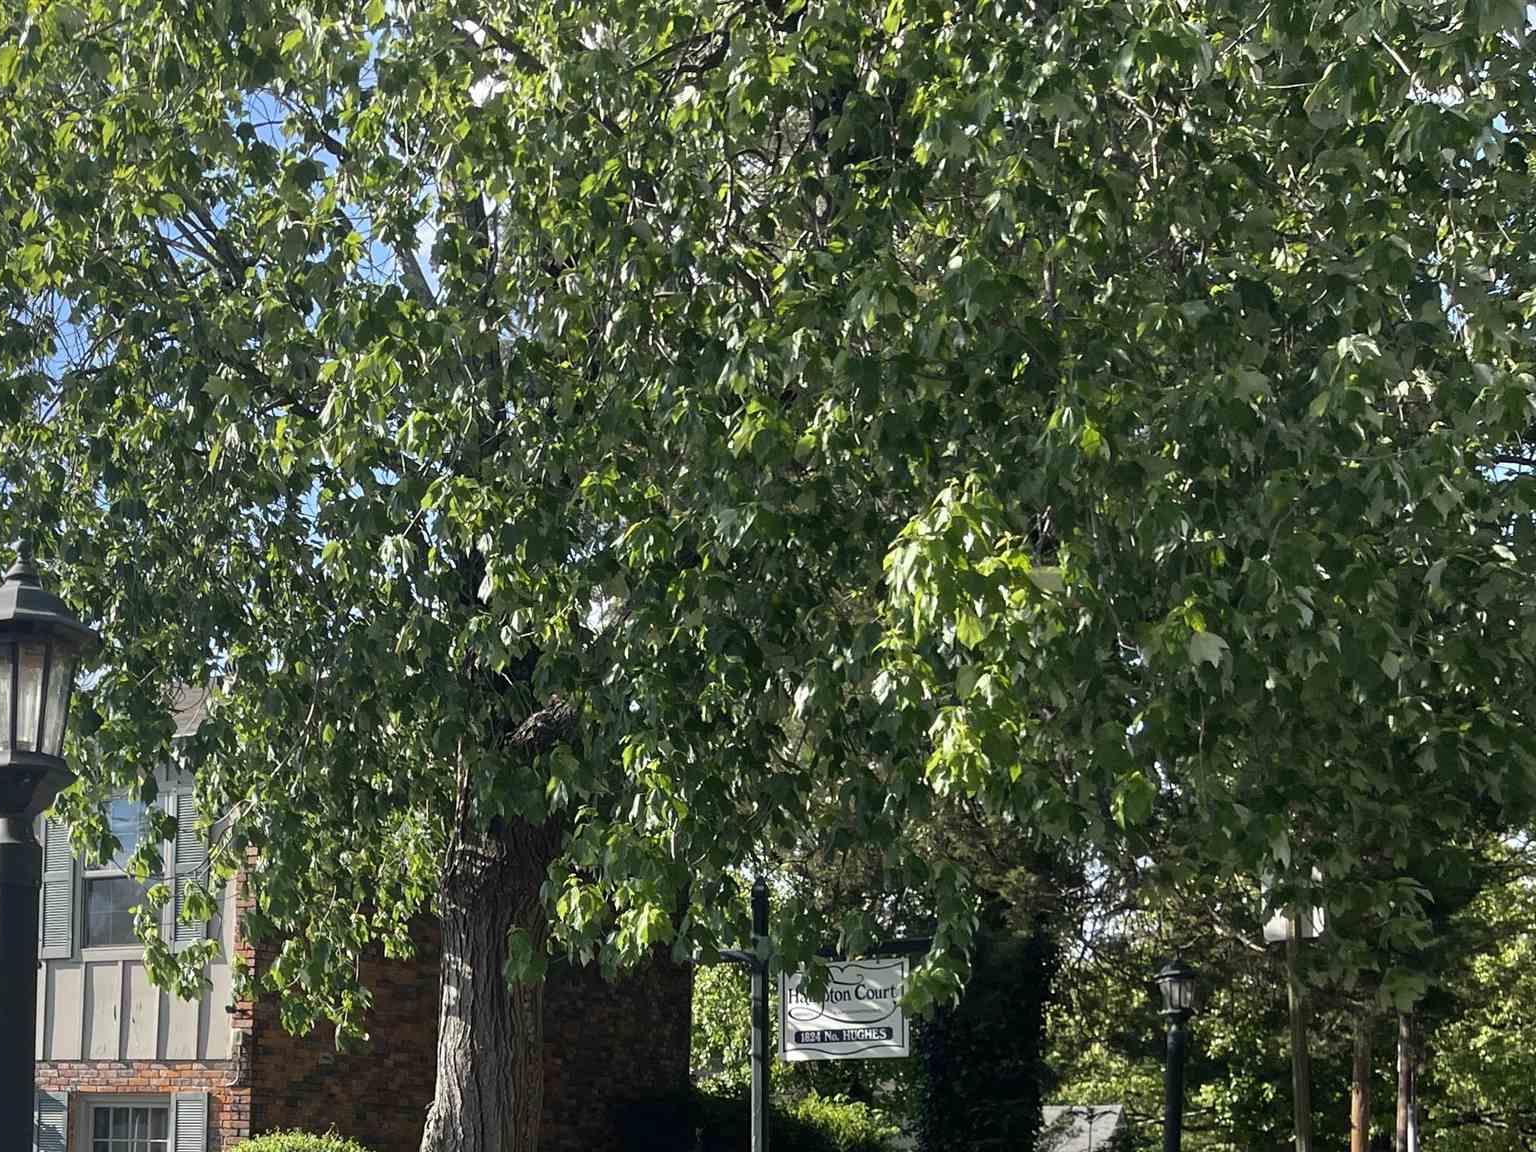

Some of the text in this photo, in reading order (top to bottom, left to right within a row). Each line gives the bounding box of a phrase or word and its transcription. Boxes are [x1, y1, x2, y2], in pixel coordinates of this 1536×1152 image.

[789, 984, 897, 1005] Hapton Court
[800, 1028, 887, 1043] 1824 No. HUGHES
